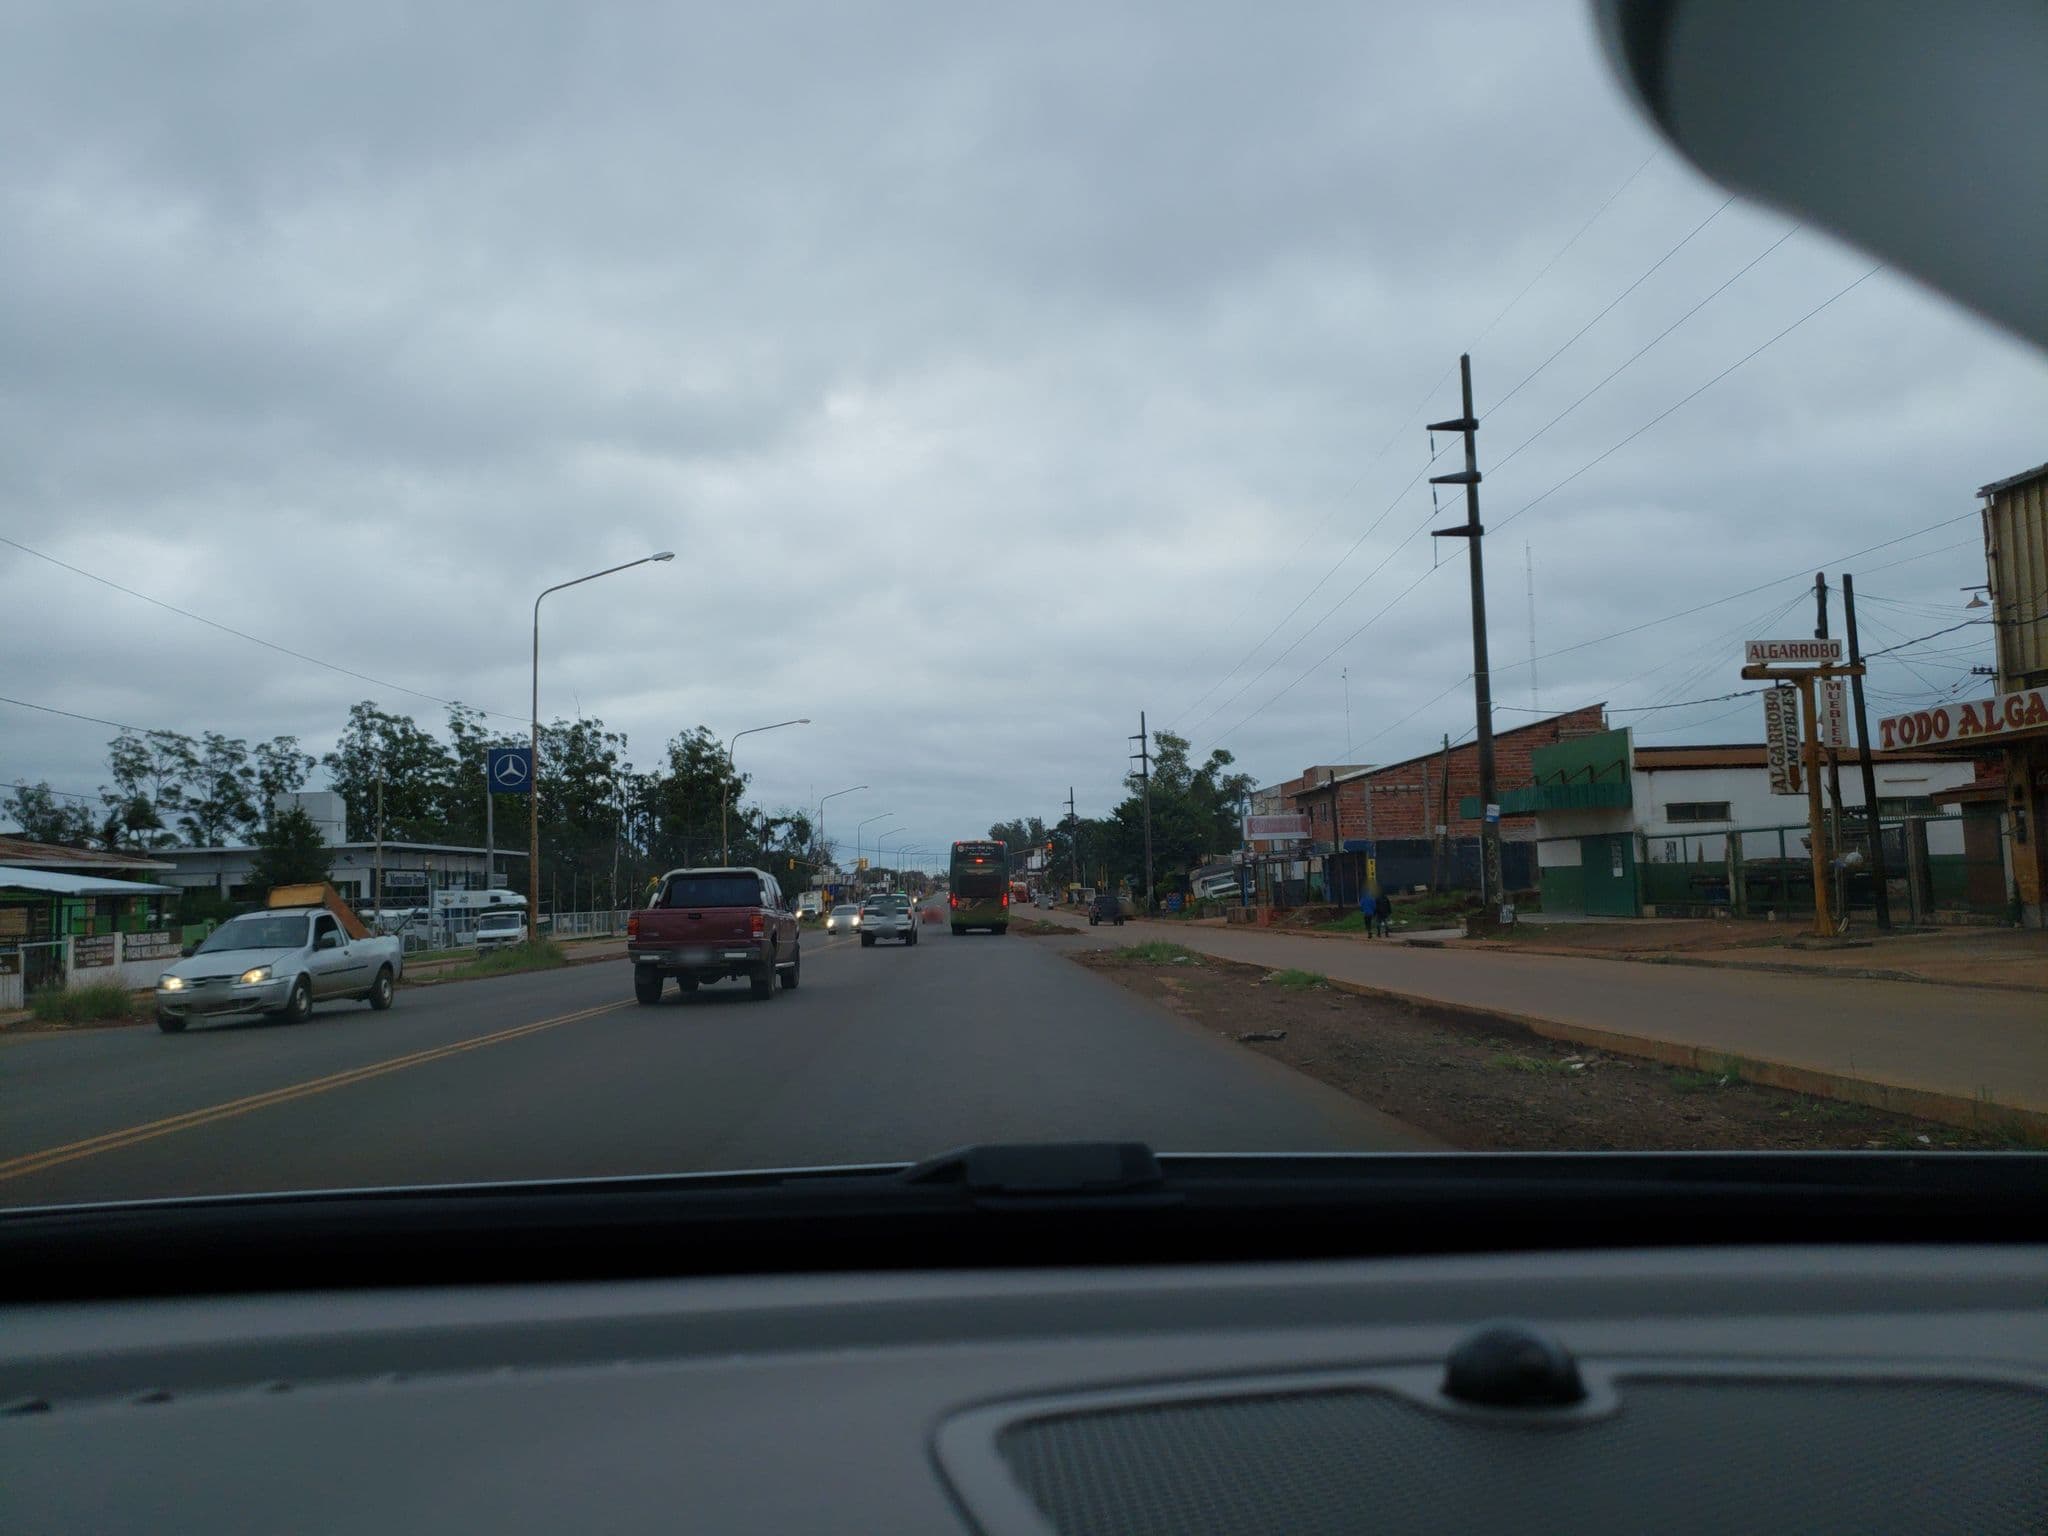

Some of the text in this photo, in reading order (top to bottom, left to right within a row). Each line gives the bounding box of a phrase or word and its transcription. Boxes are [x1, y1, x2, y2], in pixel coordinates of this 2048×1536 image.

[1750, 643, 1840, 659] ALGARROBO
[1767, 691, 1788, 790] ALGARROBO
[1782, 690, 1799, 765] MUEBLES
[1826, 683, 1842, 745] MUEBLES
[1880, 692, 2048, 748] TODO ALGA
